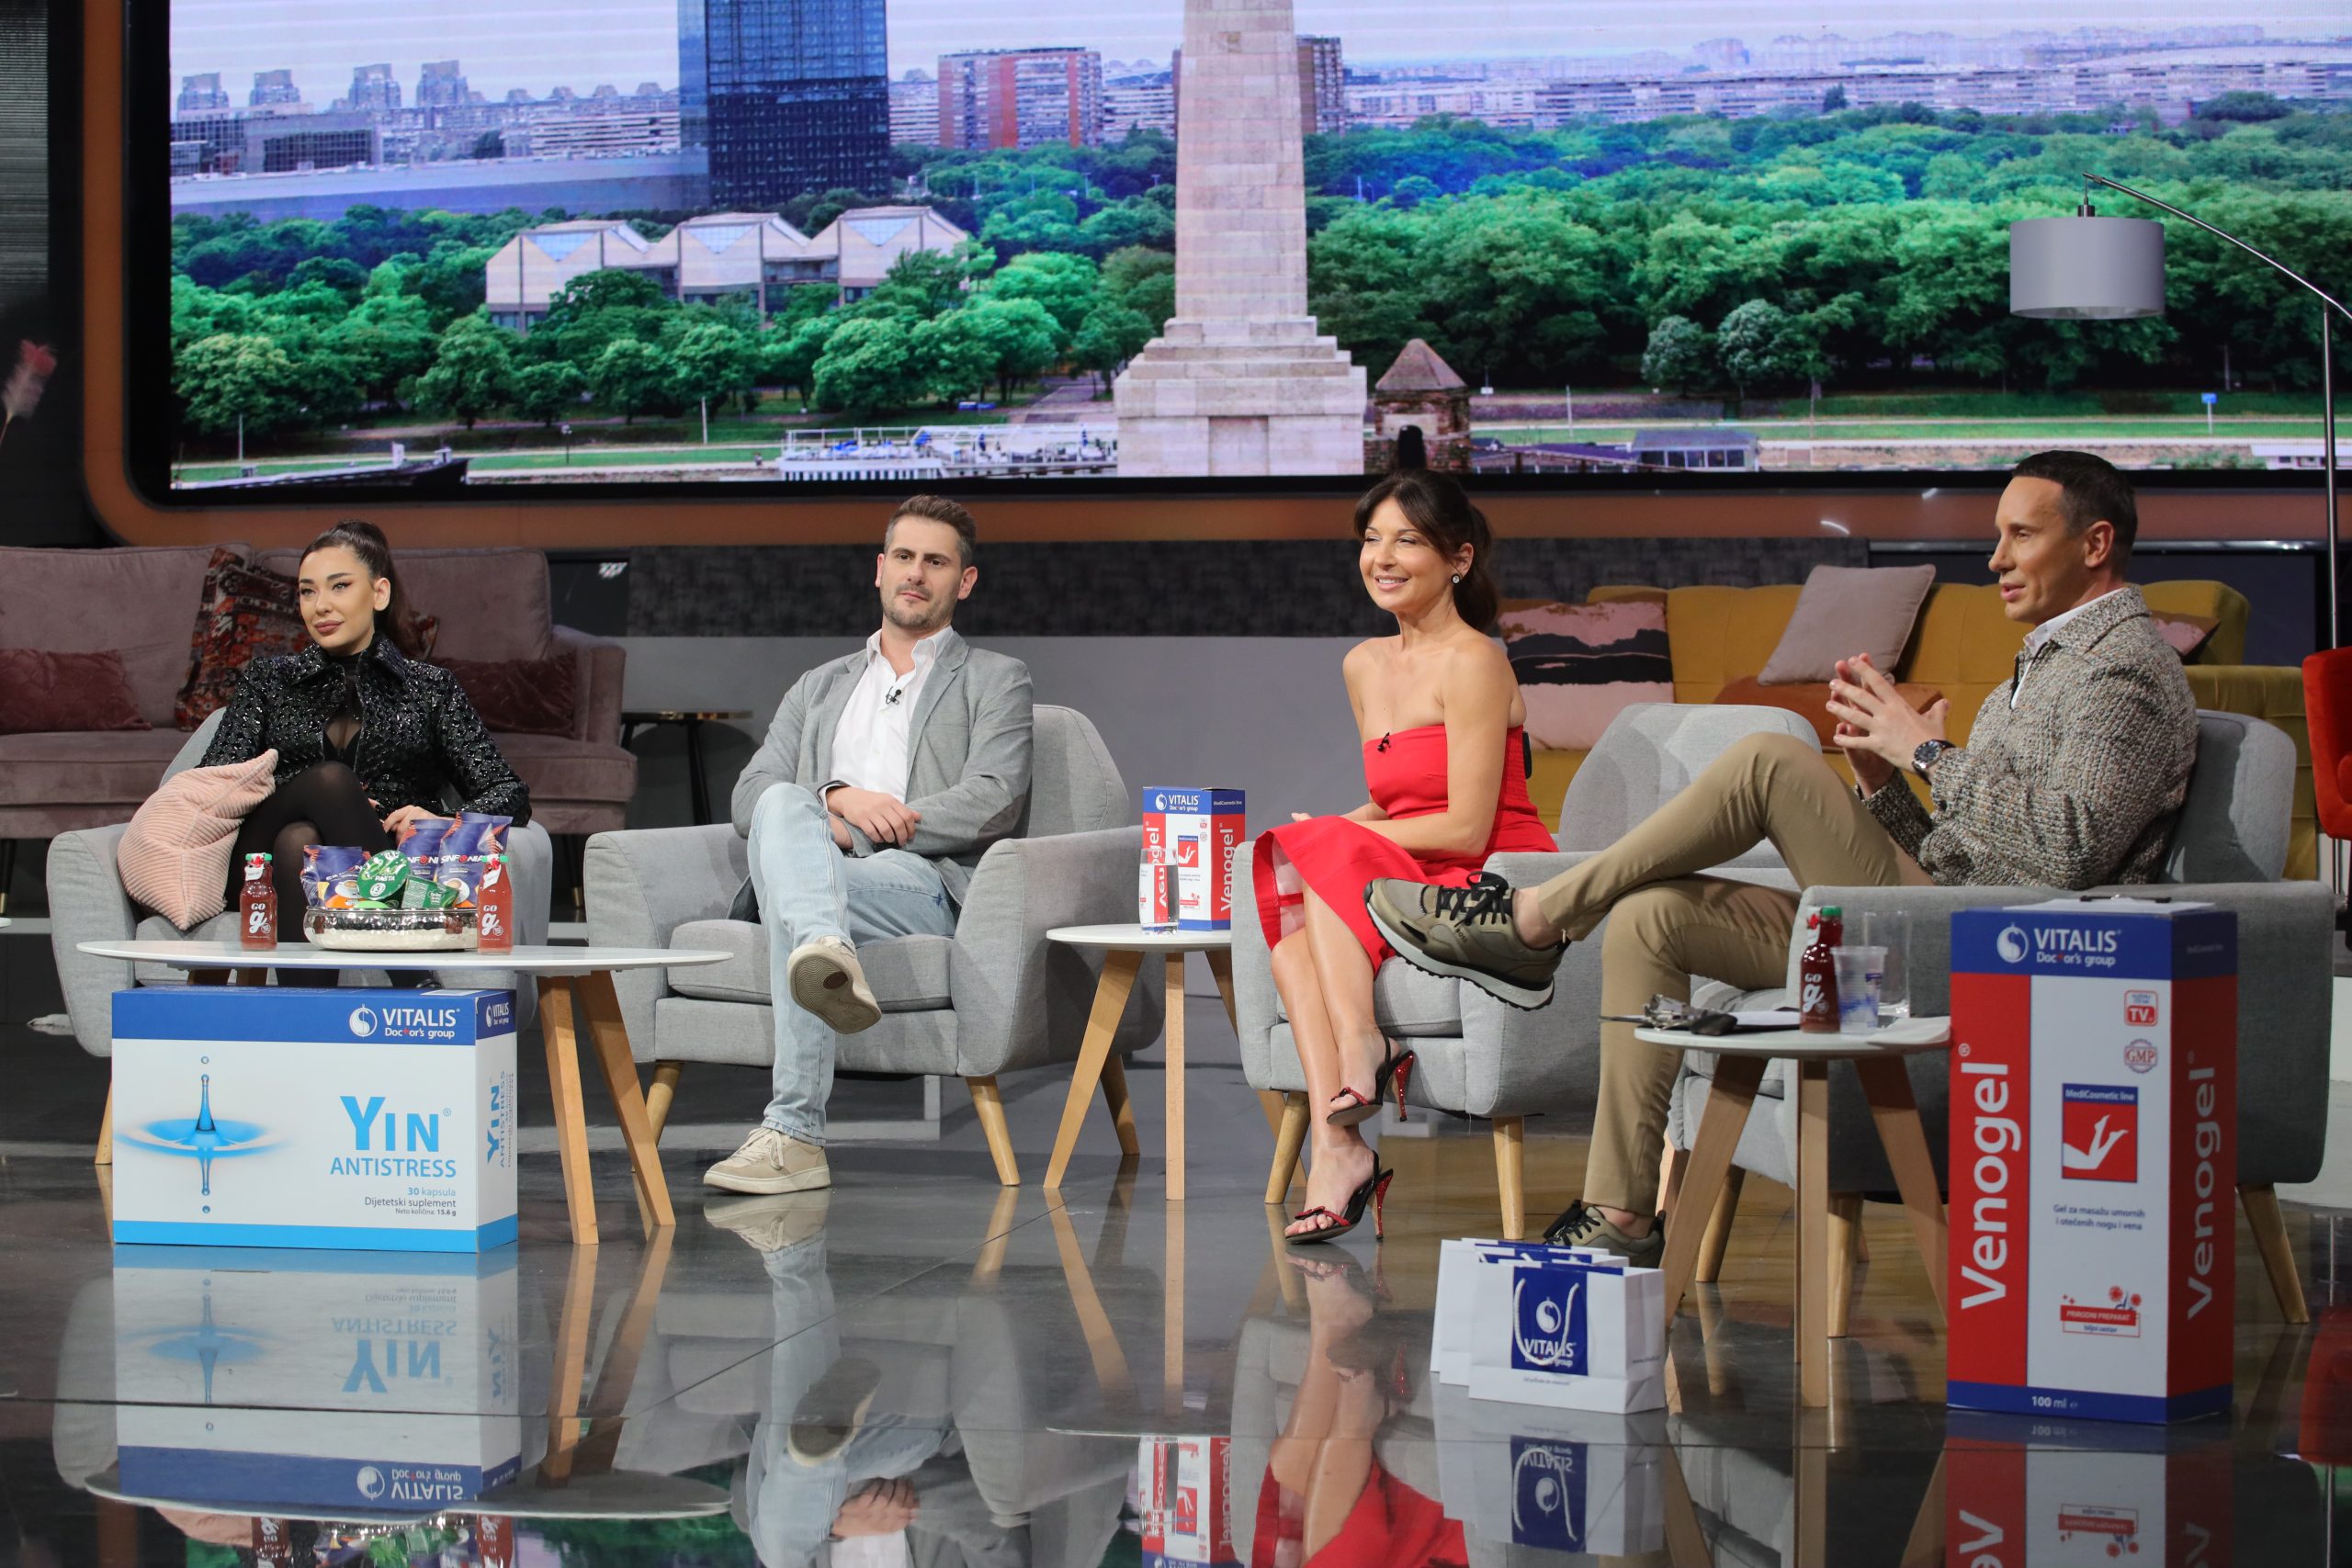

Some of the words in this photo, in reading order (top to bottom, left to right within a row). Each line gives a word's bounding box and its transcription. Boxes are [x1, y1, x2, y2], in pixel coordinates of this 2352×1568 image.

[1168, 794, 1199, 806] VITALIS
[407, 854, 439, 864] NFONI
[1219, 829, 1237, 912] Venogel
[2033, 928, 2118, 953] VITALIS
[2084, 954, 2116, 967] group
[382, 1008, 457, 1027] VITALIS
[2130, 1008, 2150, 1022] TV
[427, 1030, 456, 1040] group
[2125, 1049, 2154, 1063] GMP
[2064, 1089, 2119, 1101] MediCosmetic
[2120, 1091, 2134, 1101] line
[330, 1156, 457, 1178] ANTISTRESS
[407, 1187, 420, 1196] 30
[421, 1188, 456, 1198] kapsula
[1961, 1062, 2021, 1310] Venogel
[2188, 1067, 2221, 1320] Venogel
[365, 1197, 406, 1207] Dijetetski
[408, 1198, 457, 1208] suplement
[2052, 1204, 2067, 1213] Gel
[2096, 1221, 2117, 1231] nogu
[2122, 1222, 2143, 1230] vena
[2030, 1395, 2052, 1407] 100
[2053, 1397, 2067, 1408] ml
